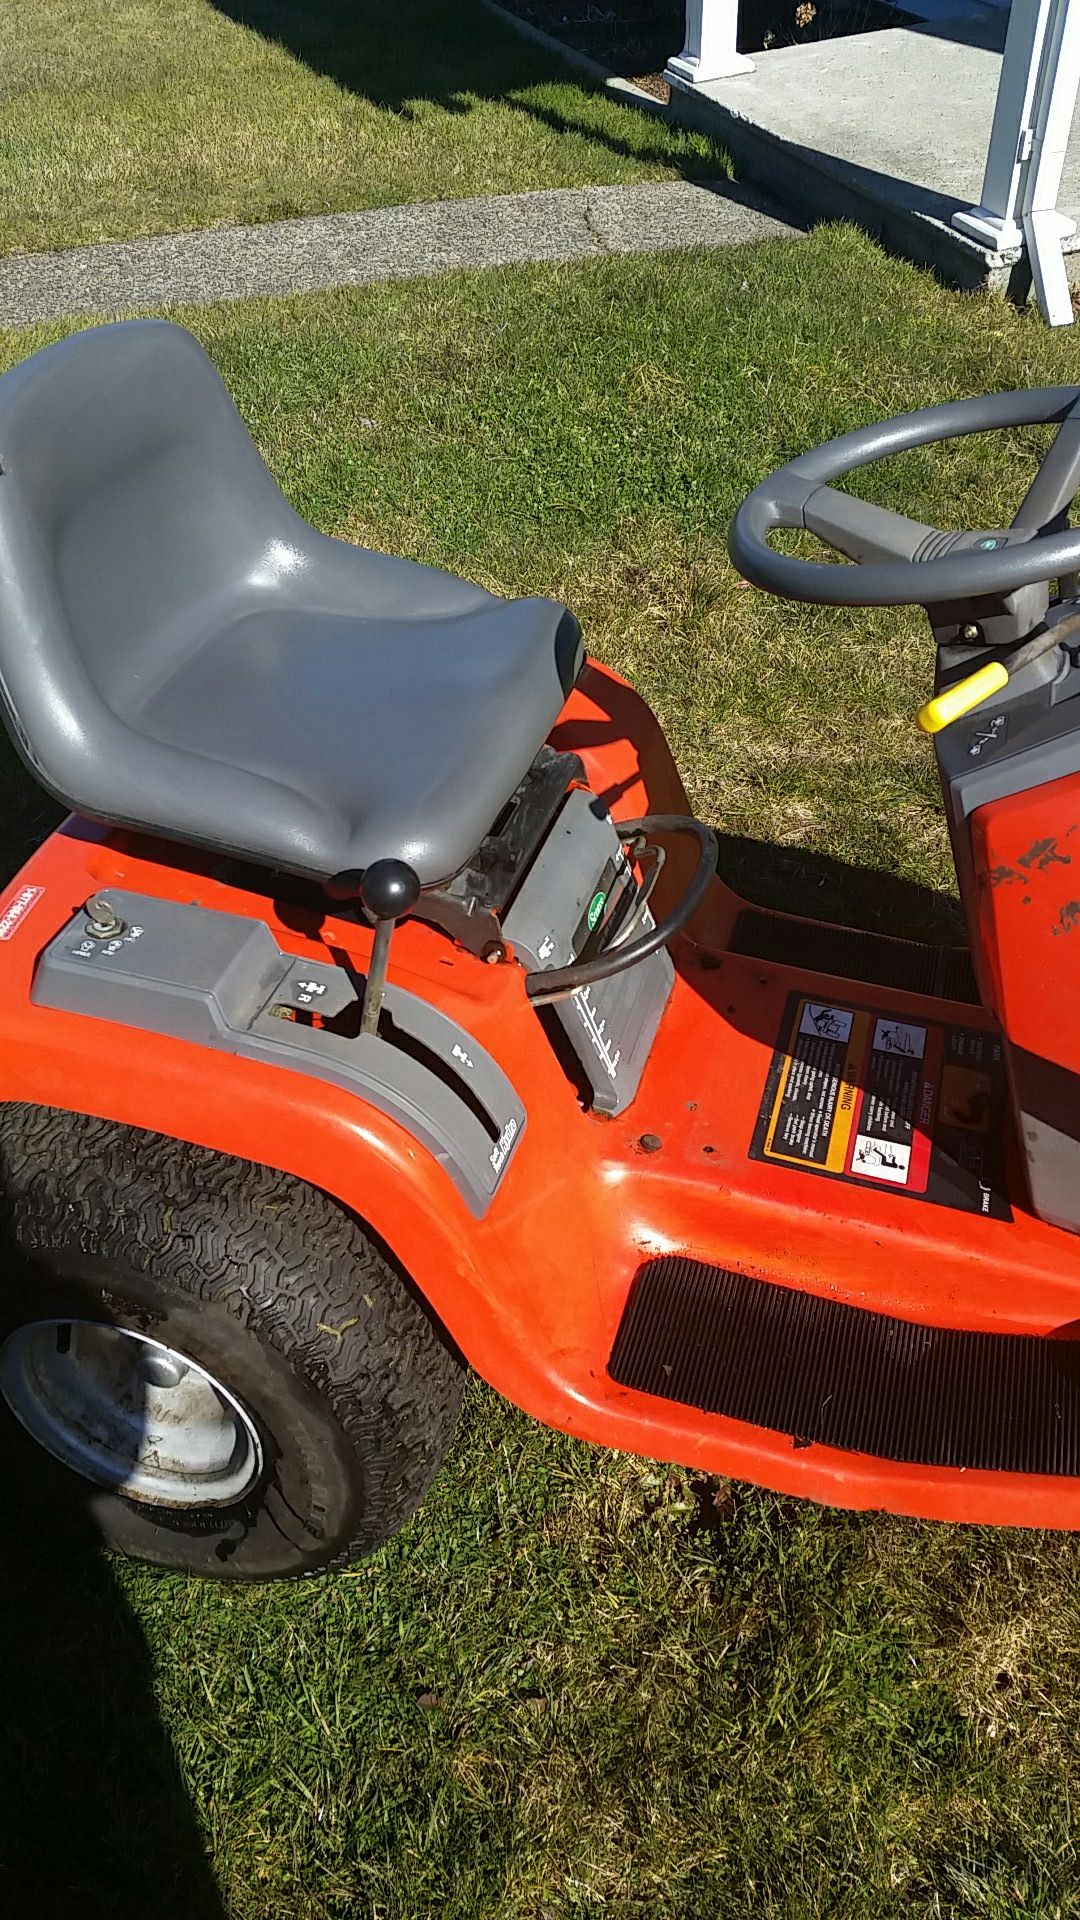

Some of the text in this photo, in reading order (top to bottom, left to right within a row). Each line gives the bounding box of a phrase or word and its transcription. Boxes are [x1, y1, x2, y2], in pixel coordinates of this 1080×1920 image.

[298, 993, 311, 1003] R
[919, 1088, 932, 1124] DANGER
[499, 1118, 517, 1155] Hydro
[821, 1119, 829, 1137] DEATH
